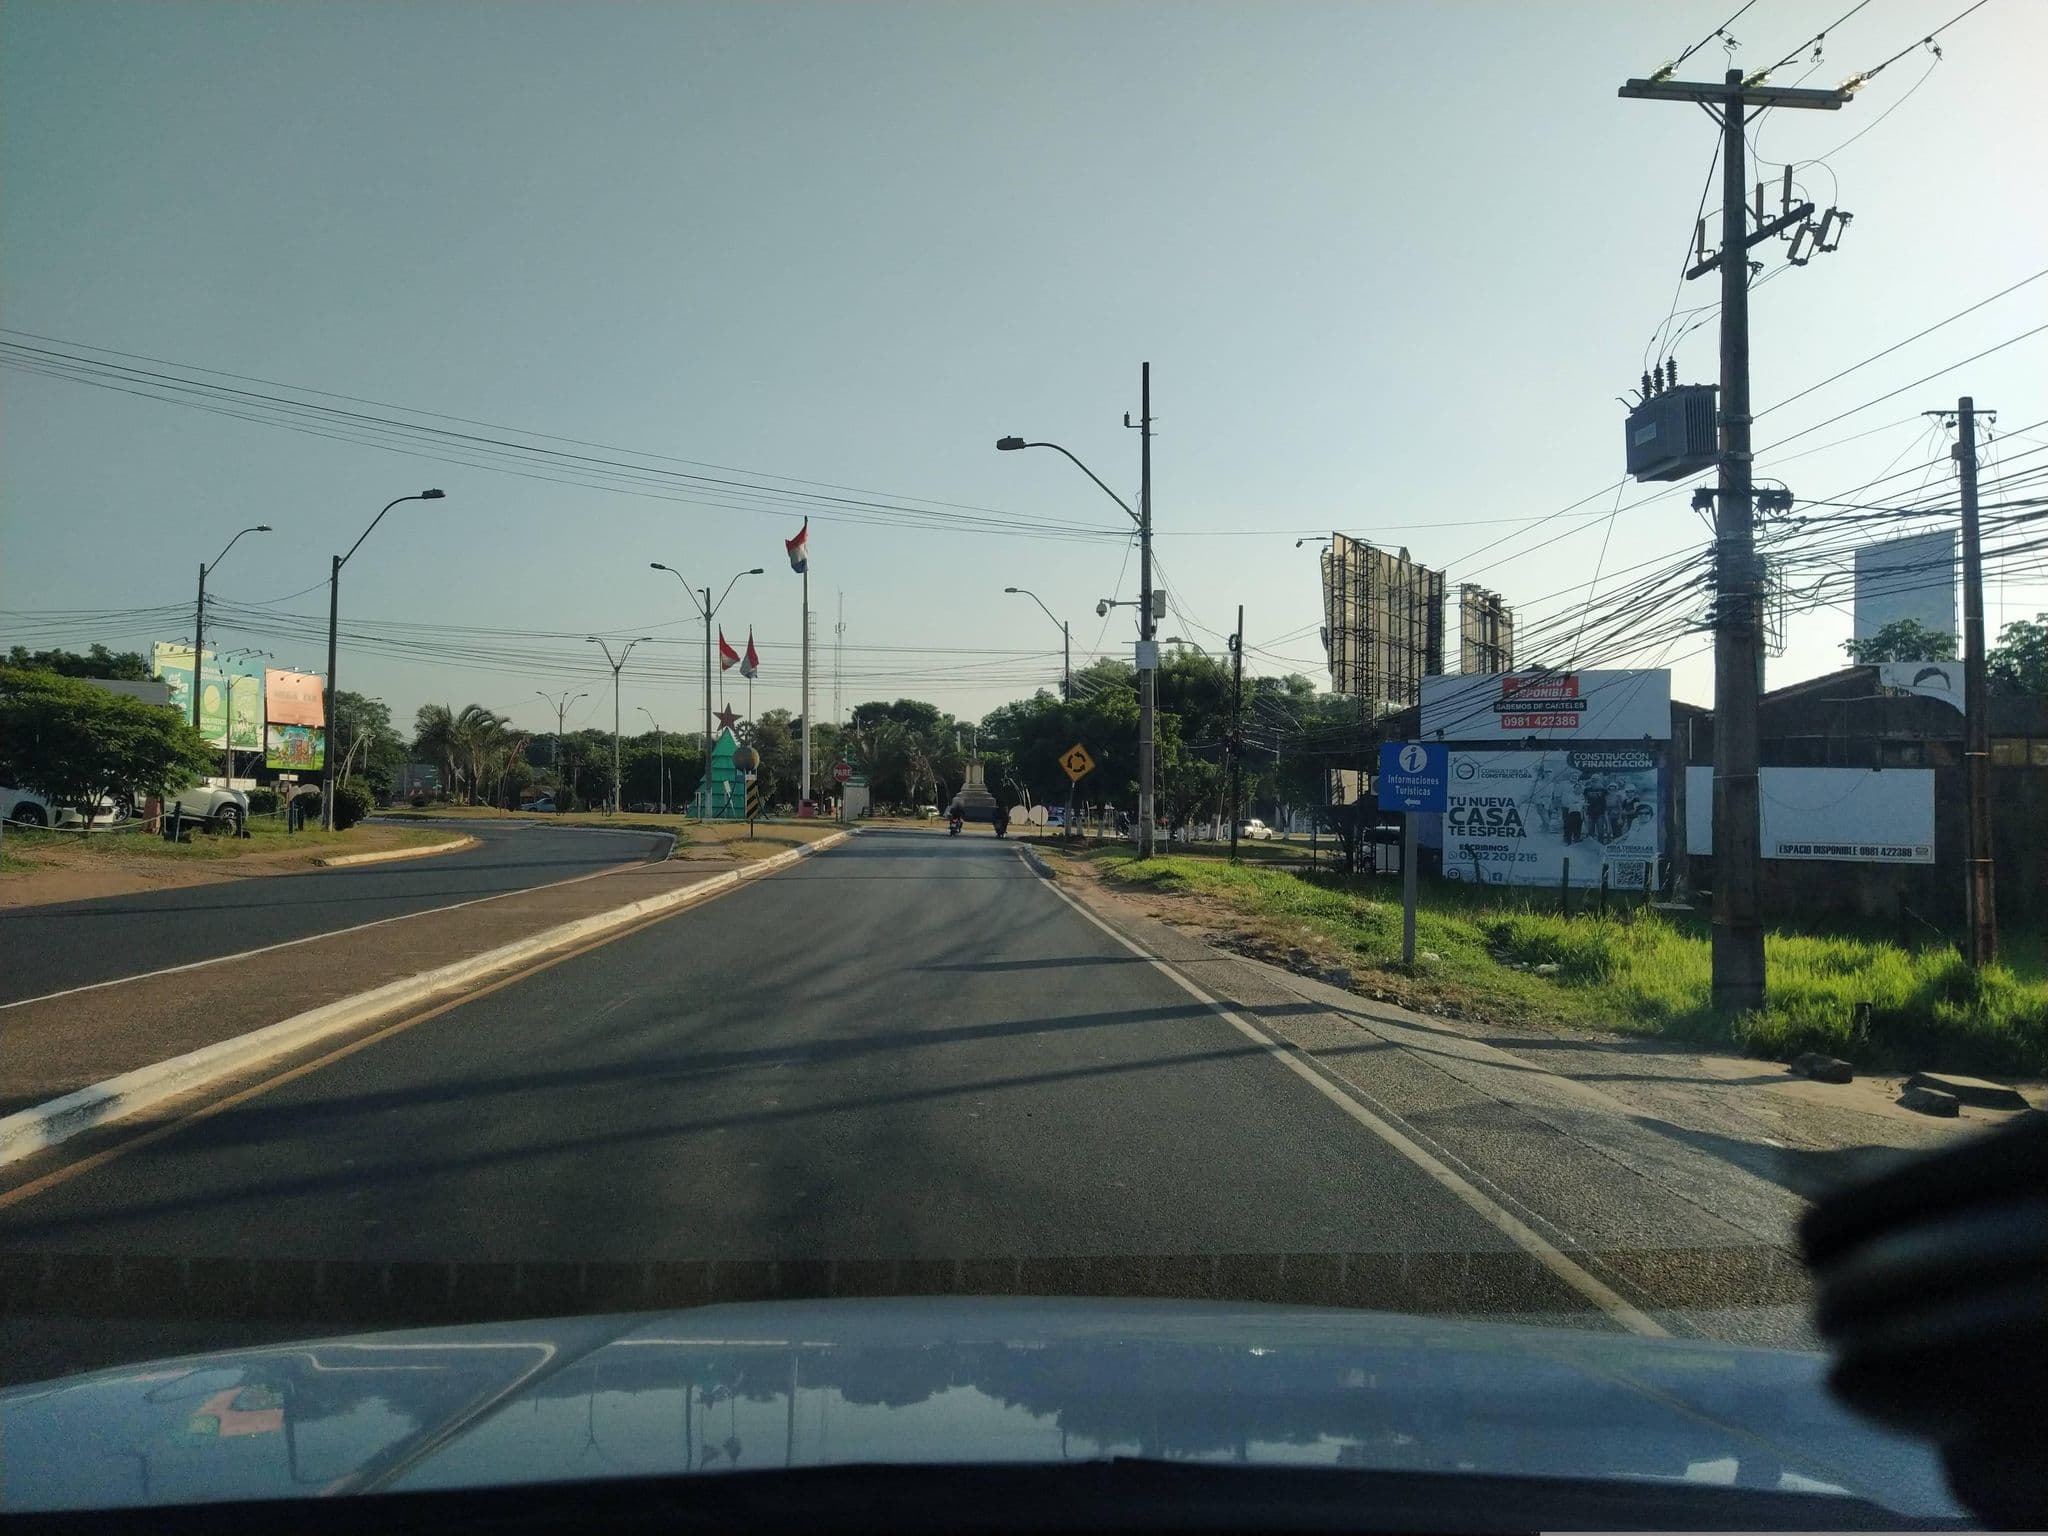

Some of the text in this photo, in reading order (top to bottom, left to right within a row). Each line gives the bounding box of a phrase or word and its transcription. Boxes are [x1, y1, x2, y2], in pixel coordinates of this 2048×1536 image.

[1504, 715, 1576, 726] 0981 422386
[1388, 774, 1440, 785] Informaciones
[1448, 796, 1515, 807] TU NUEVA
[1448, 807, 1522, 827] CASA
[1448, 826, 1527, 838] TE ESPERA
[1778, 844, 1811, 855] ESPACIO
[1813, 845, 1857, 856] DISPONIBLE
[1492, 852, 1515, 862] 208
[1518, 853, 1538, 862] 216
